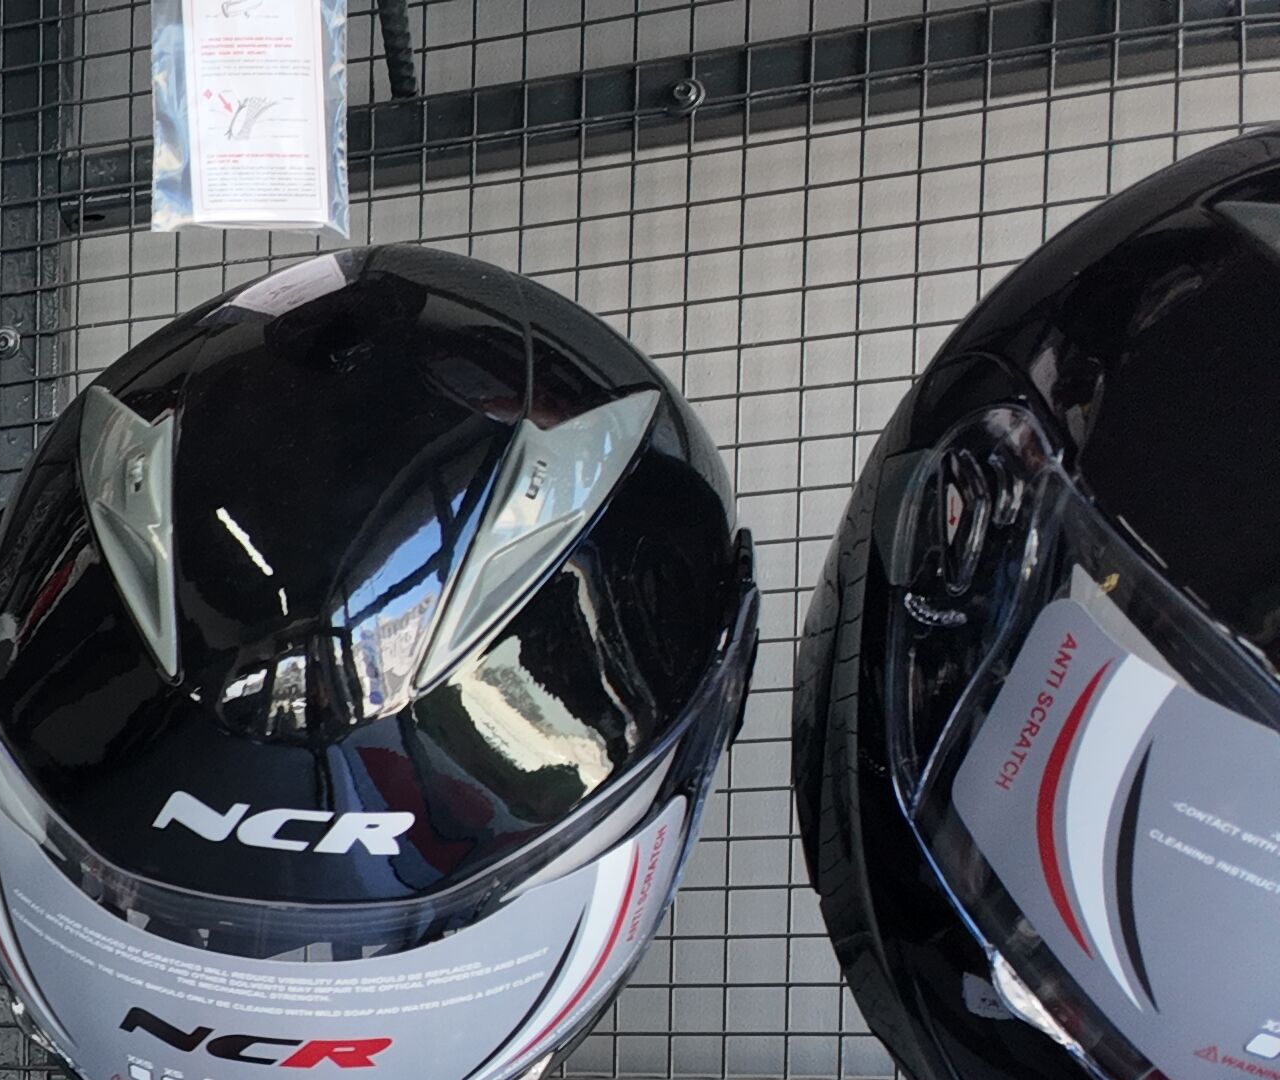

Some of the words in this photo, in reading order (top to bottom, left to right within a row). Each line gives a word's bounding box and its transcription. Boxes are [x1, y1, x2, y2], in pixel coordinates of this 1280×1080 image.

[1046, 633, 1077, 688] ANTI
[995, 692, 1053, 790] SCRATCH
[152, 791, 416, 856] NCR
[1150, 829, 1215, 865] CLEANING
[1242, 832, 1277, 853] WITH
[627, 905, 642, 942] ANTI
[640, 824, 667, 903] SCRATCH
[119, 1007, 392, 1068] NCR
